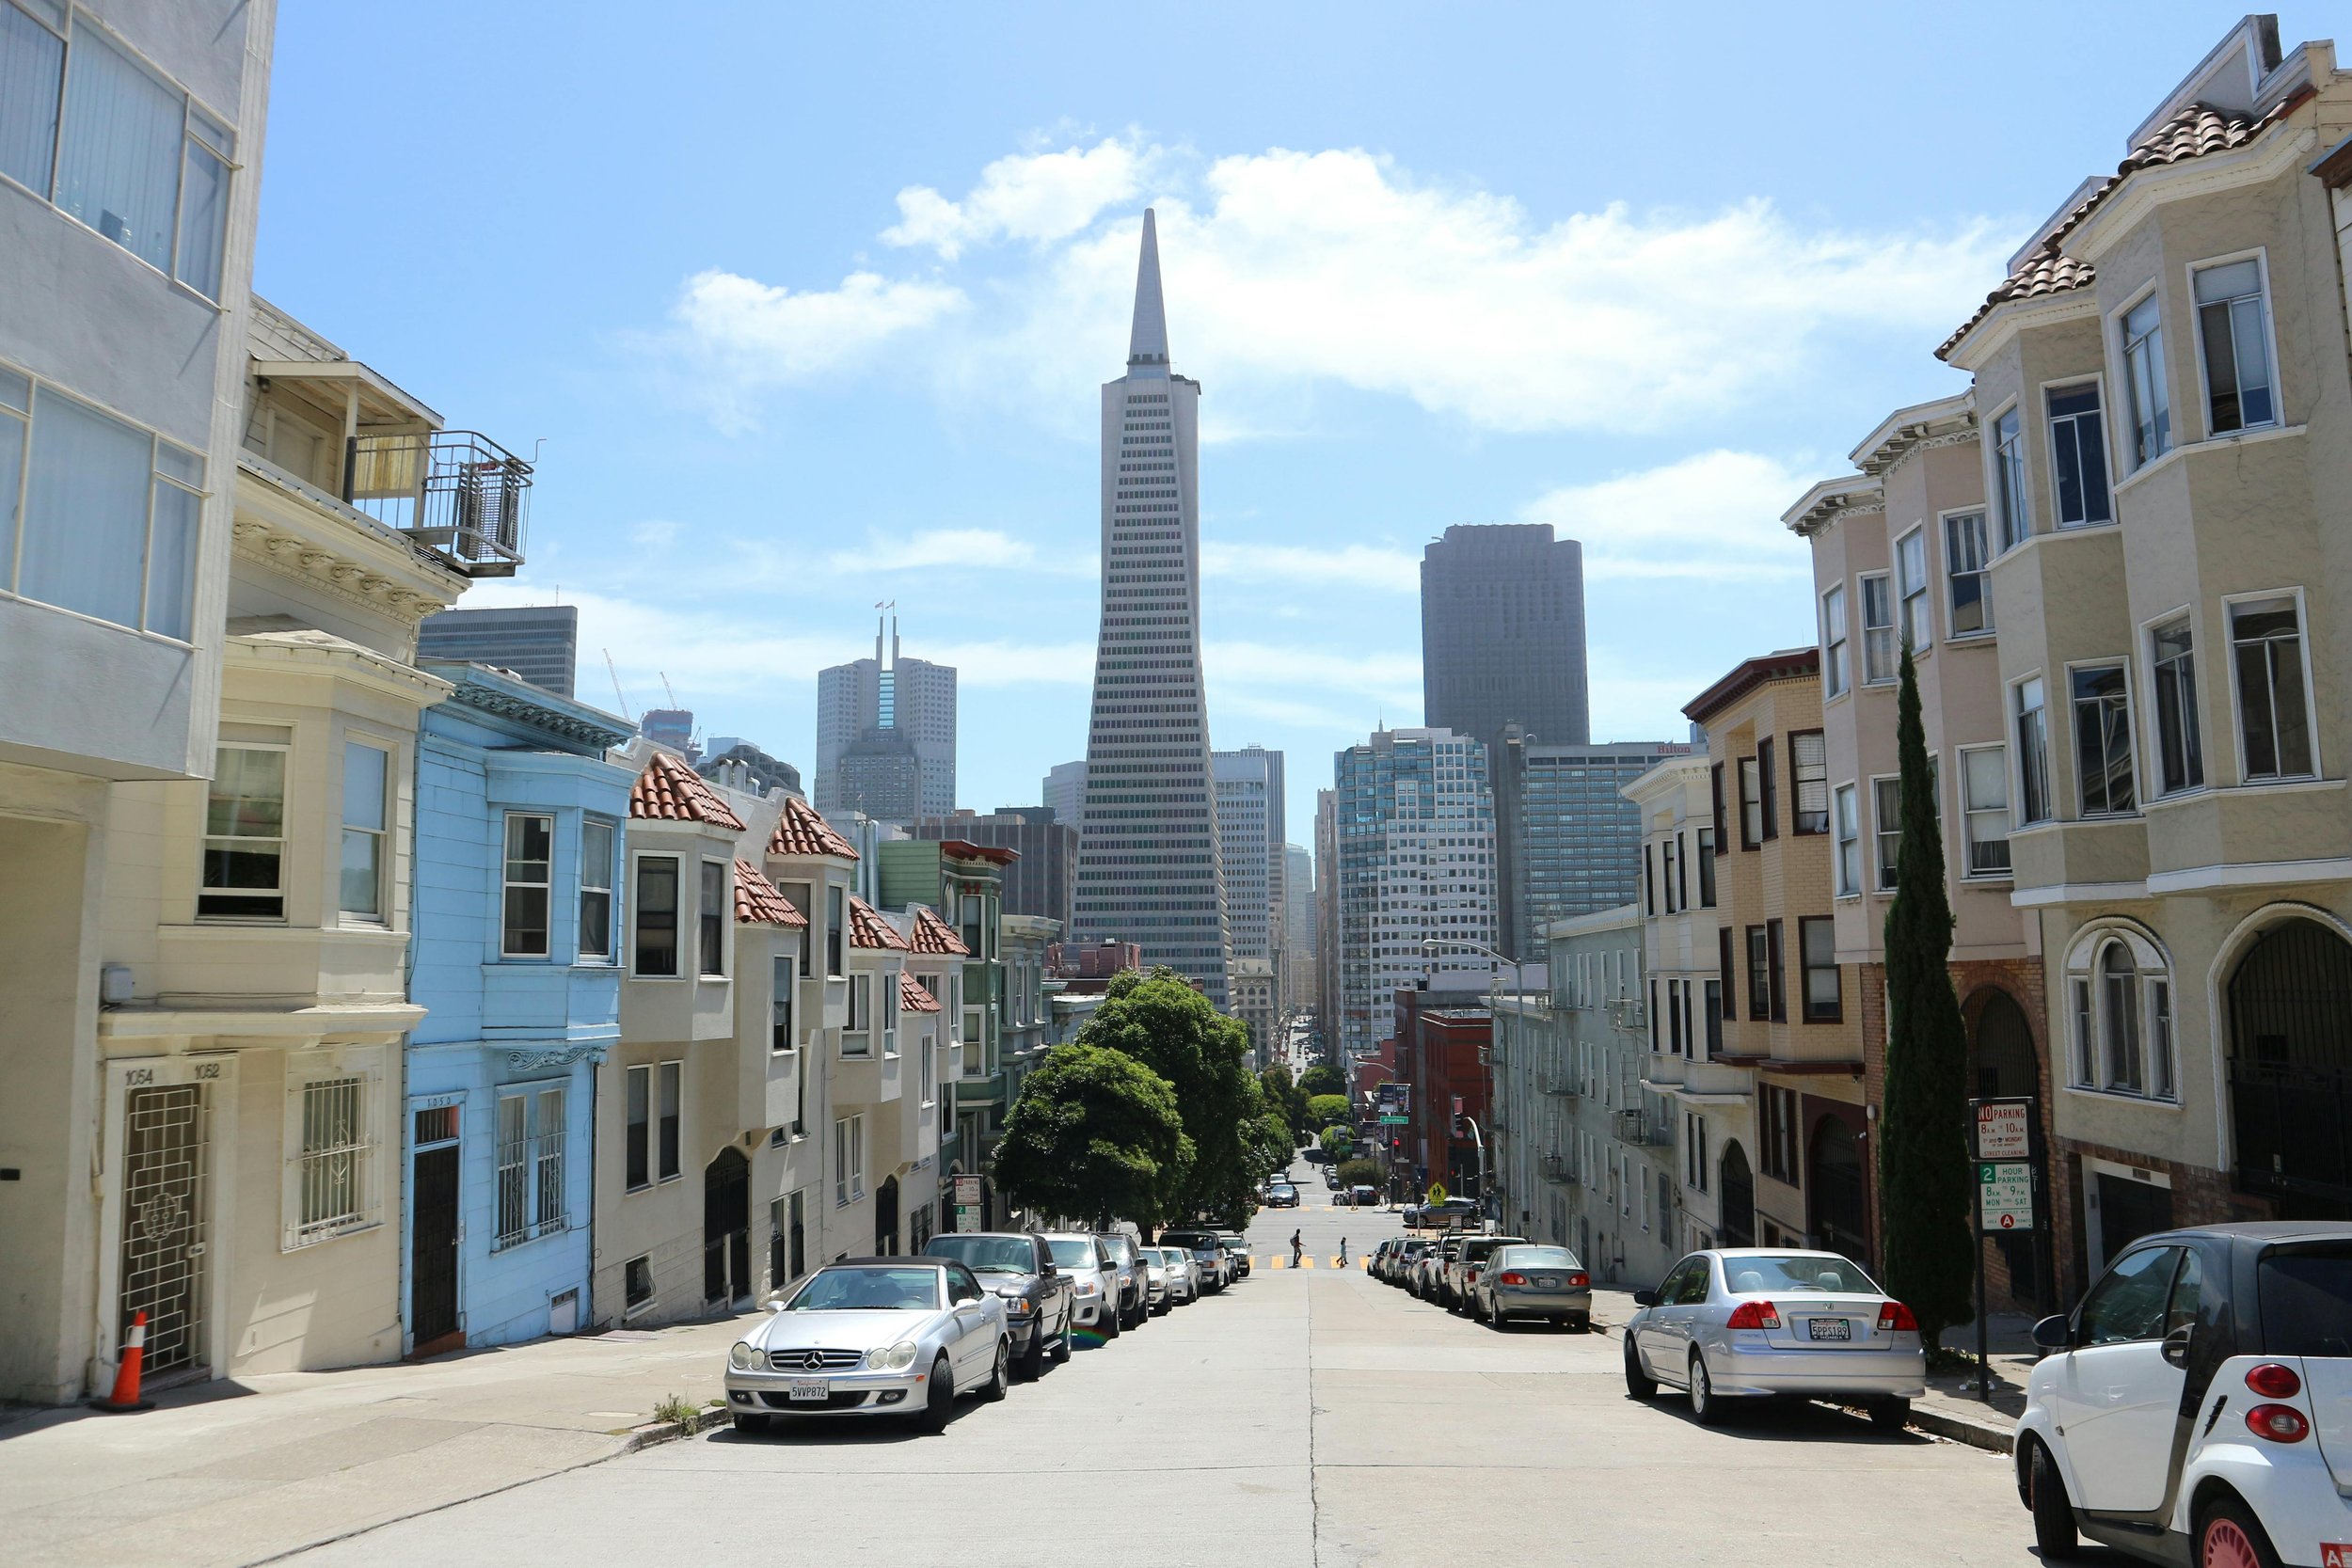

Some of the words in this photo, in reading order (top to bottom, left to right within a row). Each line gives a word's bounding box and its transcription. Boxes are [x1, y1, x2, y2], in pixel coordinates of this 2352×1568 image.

[1657, 745, 1691, 753] Hilton
[125, 1069, 153, 1085] 1054
[195, 1063, 220, 1080] 1052
[427, 1097, 451, 1108] 1050
[1979, 1106, 1992, 1120] NO
[1994, 1108, 2026, 1119] PARKING
[1983, 1167, 1993, 1181] 2
[2014, 1197, 2027, 1206] SAT
[2003, 1215, 2012, 1227] A
[1812, 1327, 1847, 1337] 5PPS189
[792, 1387, 826, 1397] 5VVP872
[2327, 1549, 2343, 1567] A
